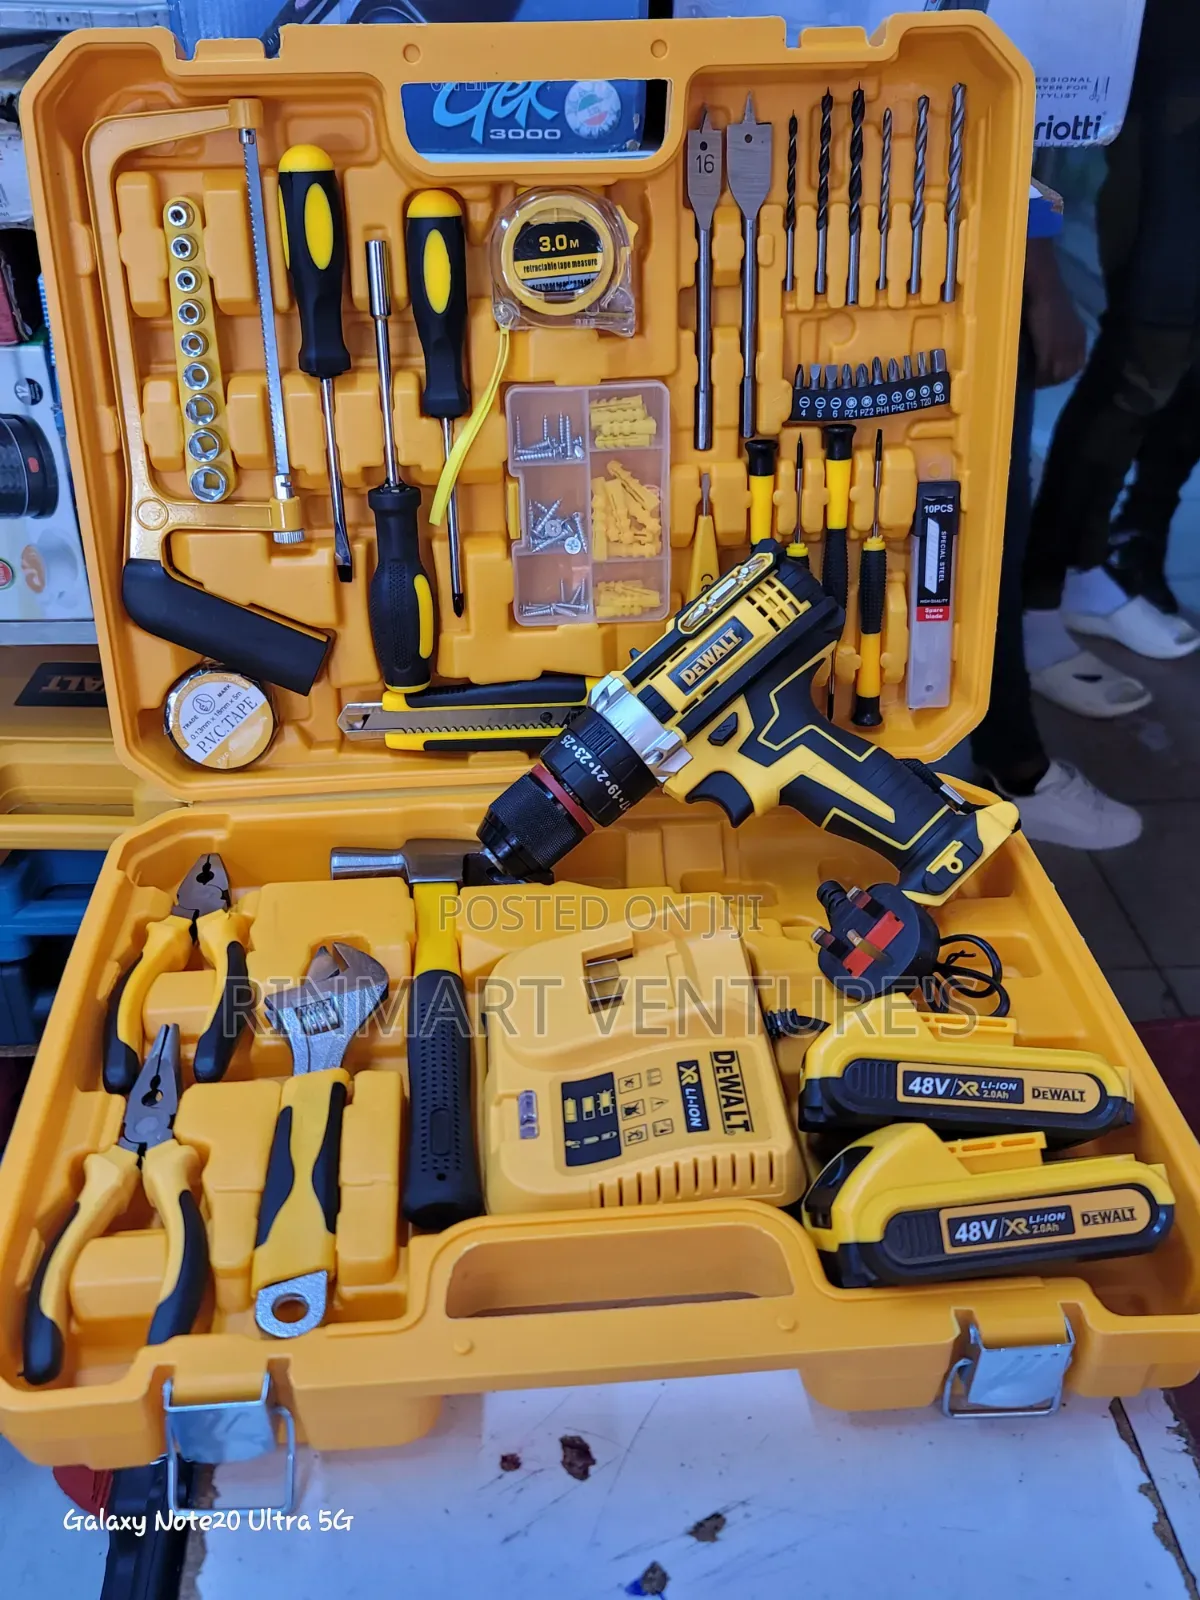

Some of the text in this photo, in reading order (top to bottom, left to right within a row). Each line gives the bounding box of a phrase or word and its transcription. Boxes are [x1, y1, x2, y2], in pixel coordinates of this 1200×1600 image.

[489, 128, 561, 140] 3000
[696, 153, 715, 174] 16
[523, 257, 598, 274] retractable tape measure
[800, 393, 945, 418] 4 5 6 PZ1 PZ2 PH1 PH2 T15 T20 AD
[924, 503, 954, 514] 10PCS
[41, 675, 105, 692] ALT
[183, 684, 232, 731] TRADE MARK
[981, 1081, 1017, 1091] LI-ION
[982, 1089, 1009, 1100] 2.0Ah
[685, 1088, 703, 1128] LI-ION
[1029, 1212, 1066, 1224] LI-ION
